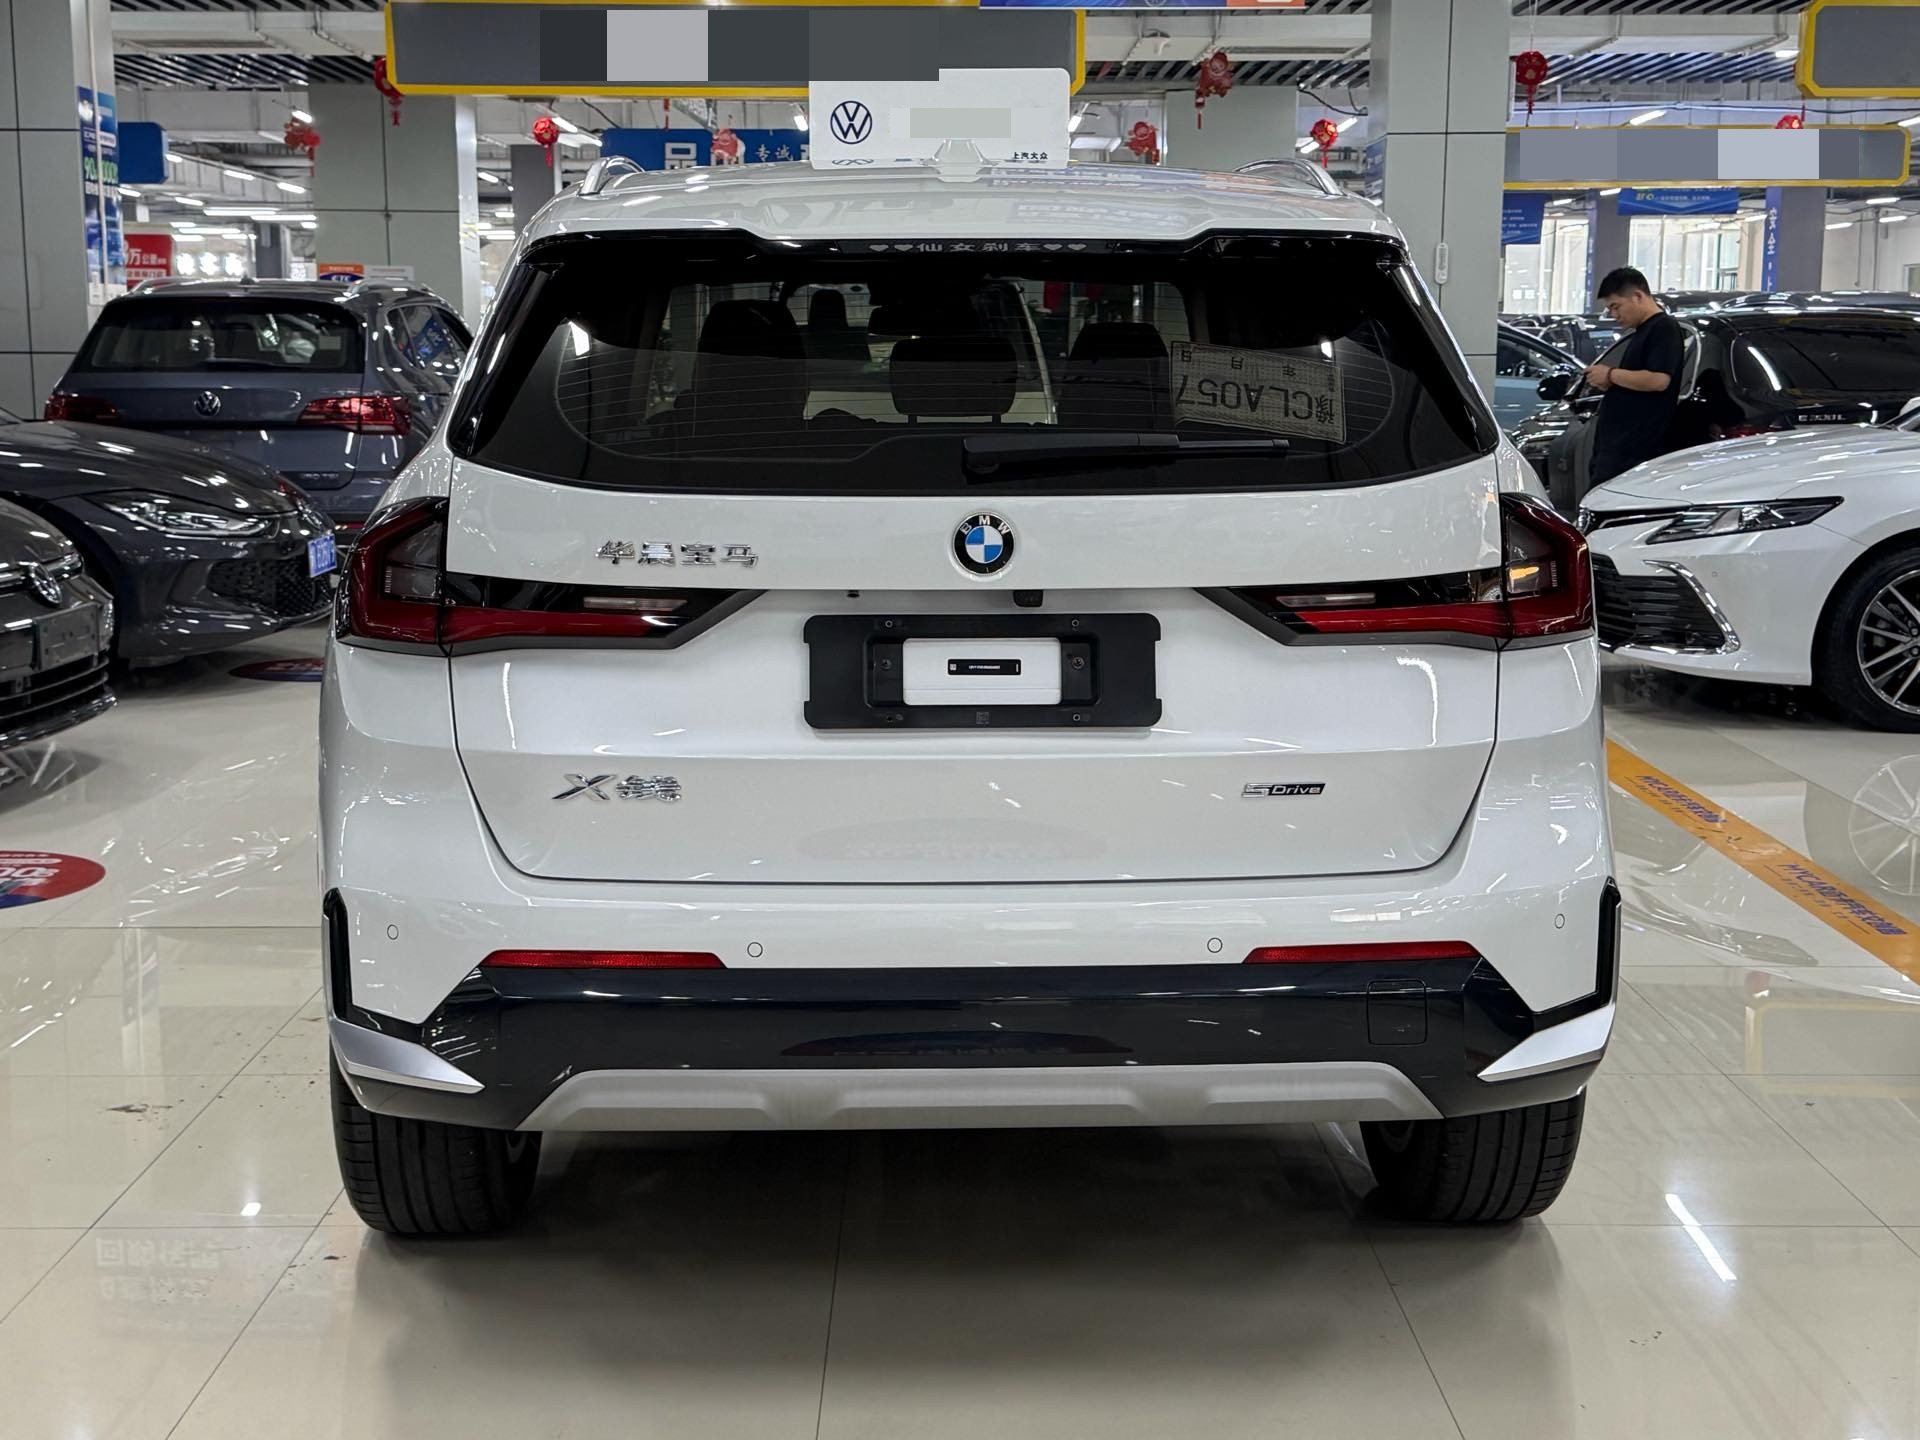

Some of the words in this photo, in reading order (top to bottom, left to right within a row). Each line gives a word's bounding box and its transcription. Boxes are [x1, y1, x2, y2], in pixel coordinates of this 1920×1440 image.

[1011, 151, 1048, 160] 上汽大众
[960, 515, 1011, 535] BMW
[596, 539, 759, 568] 华晨宝马
